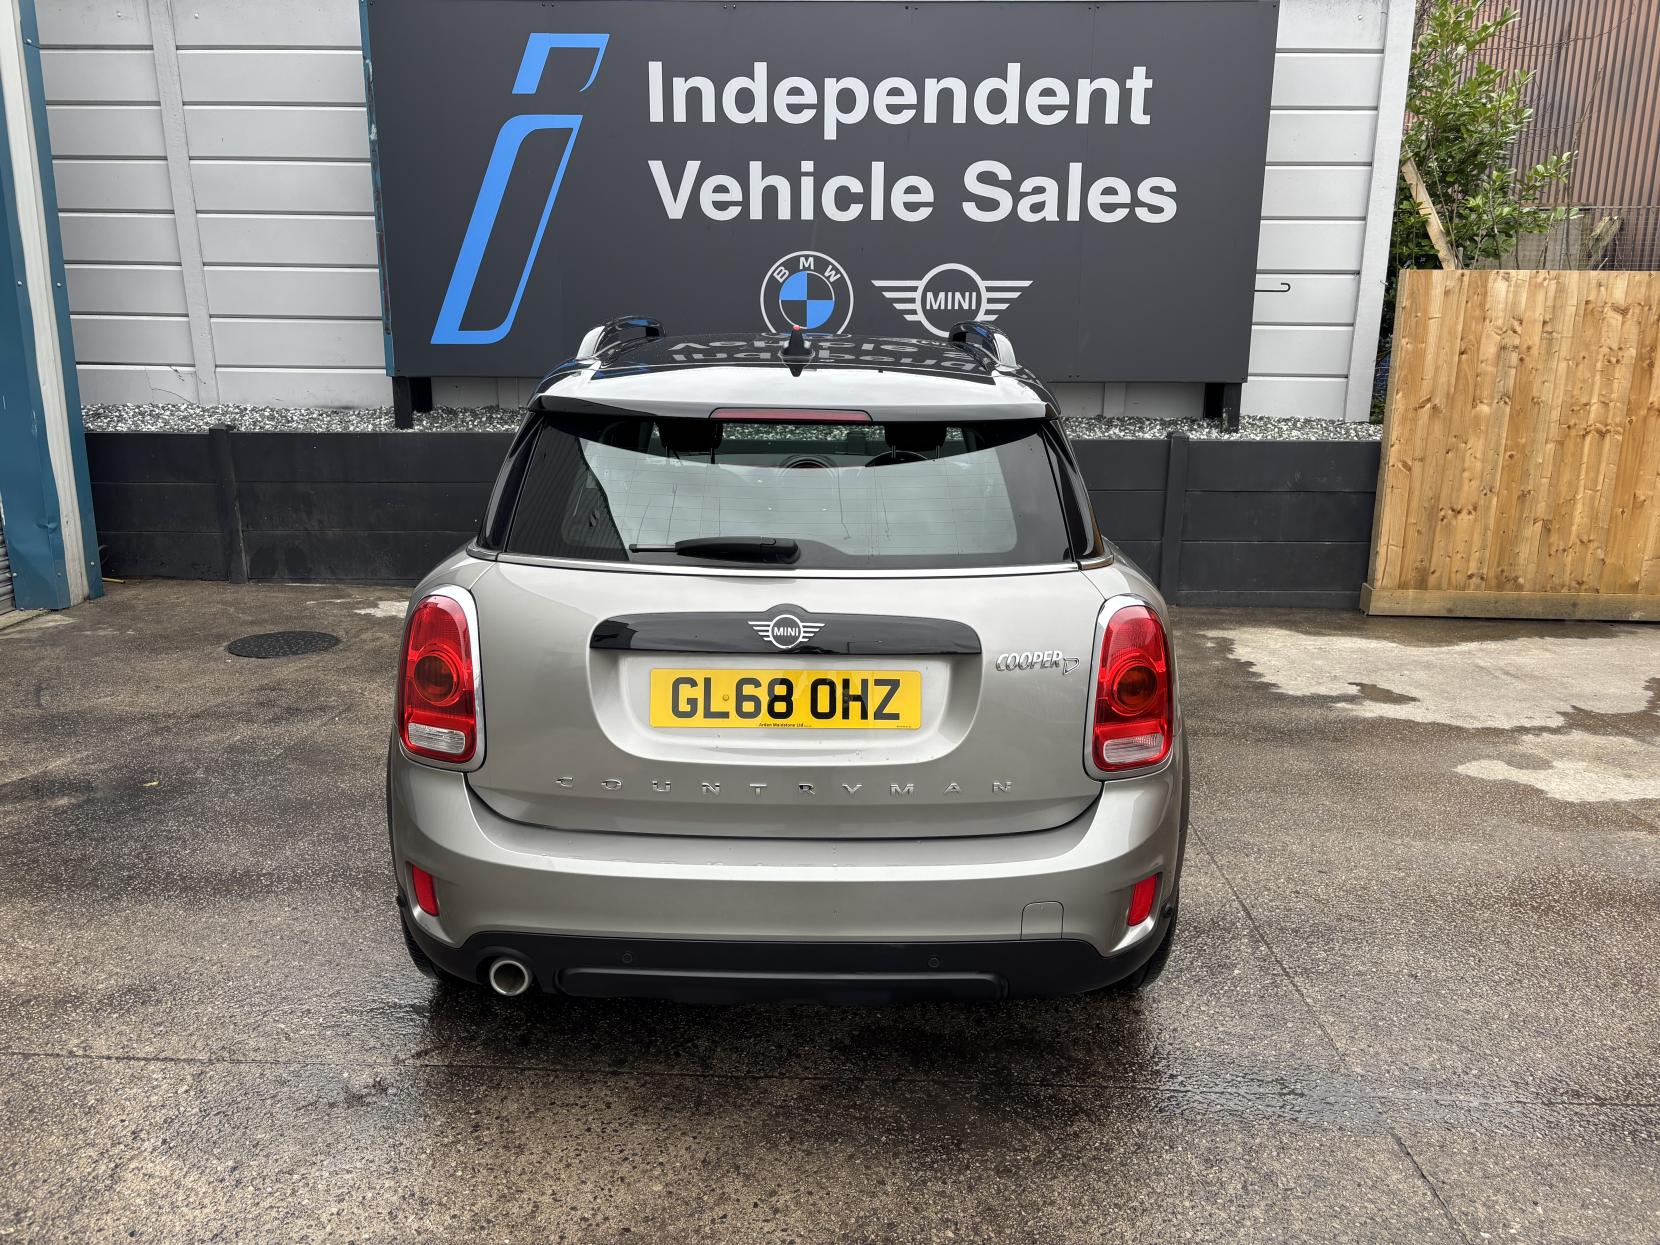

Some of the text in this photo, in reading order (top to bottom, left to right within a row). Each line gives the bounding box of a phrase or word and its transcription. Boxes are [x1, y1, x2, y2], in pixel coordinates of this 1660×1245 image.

[648, 61, 1153, 140] Independent
[648, 160, 1178, 223] Vehicle Sales
[773, 256, 841, 283] BMW
[925, 291, 977, 310] MINI
[773, 626, 799, 637] MINI
[995, 650, 1063, 672] COOPER
[671, 676, 901, 721] GL68 OHZ
[555, 776, 1013, 796] COUNTRYMAN
